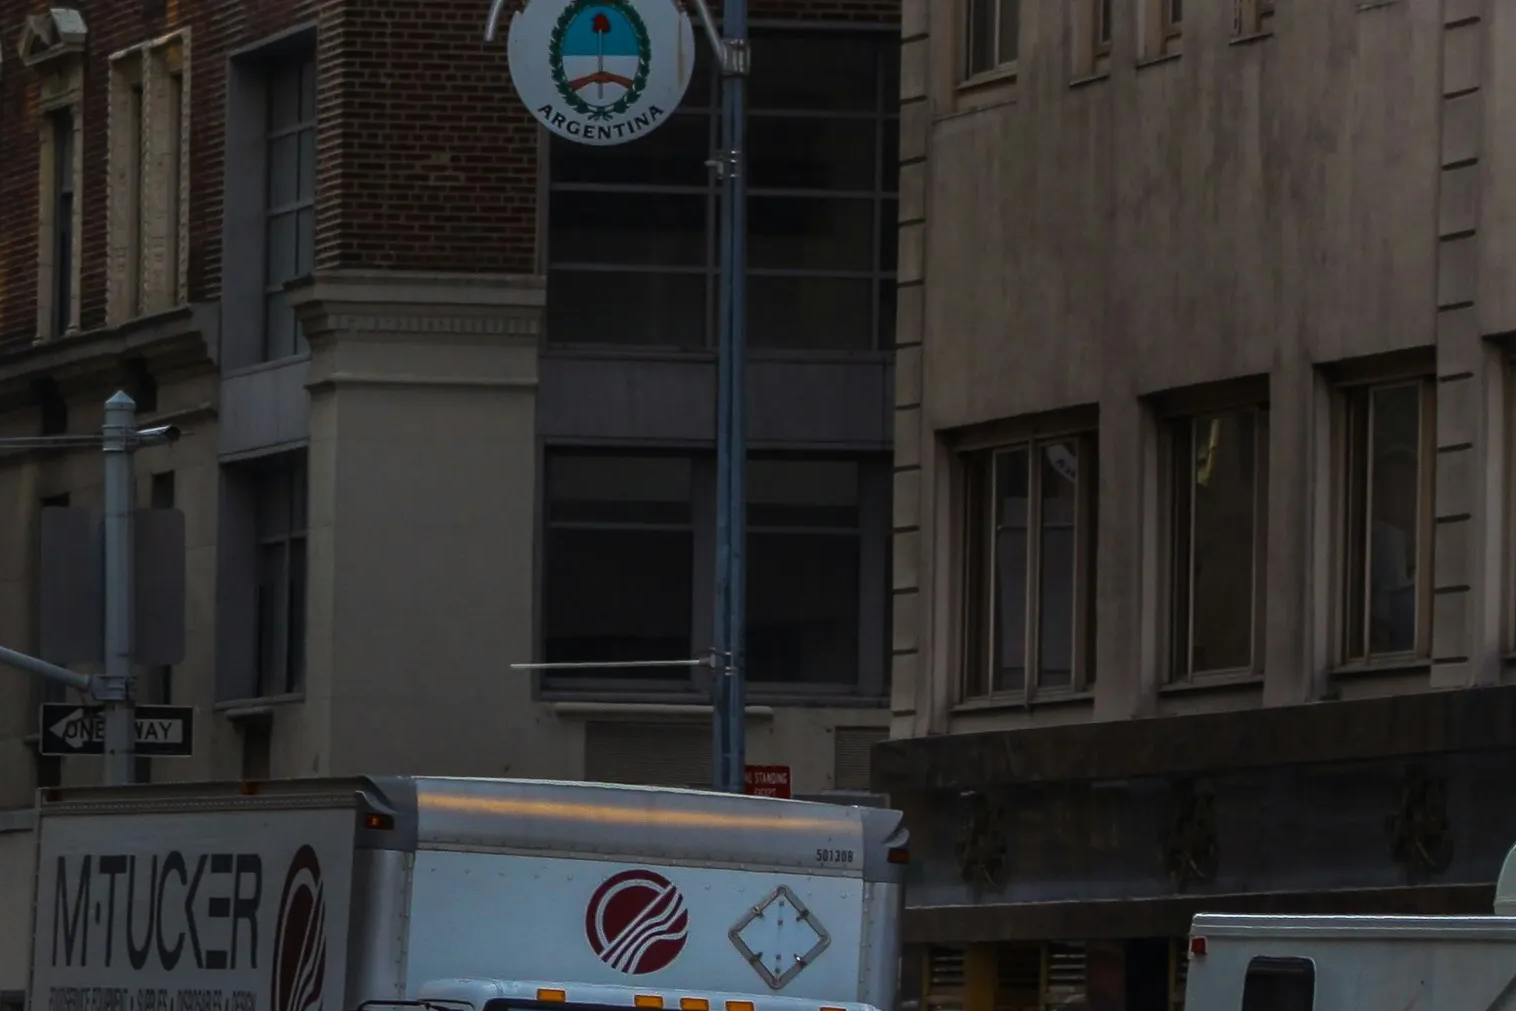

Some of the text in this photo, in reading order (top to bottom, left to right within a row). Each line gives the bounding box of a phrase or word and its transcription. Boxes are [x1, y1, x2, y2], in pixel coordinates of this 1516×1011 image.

[537, 103, 664, 140] ARGENTINA
[59, 719, 104, 740] ONE
[816, 848, 854, 863] 501308
